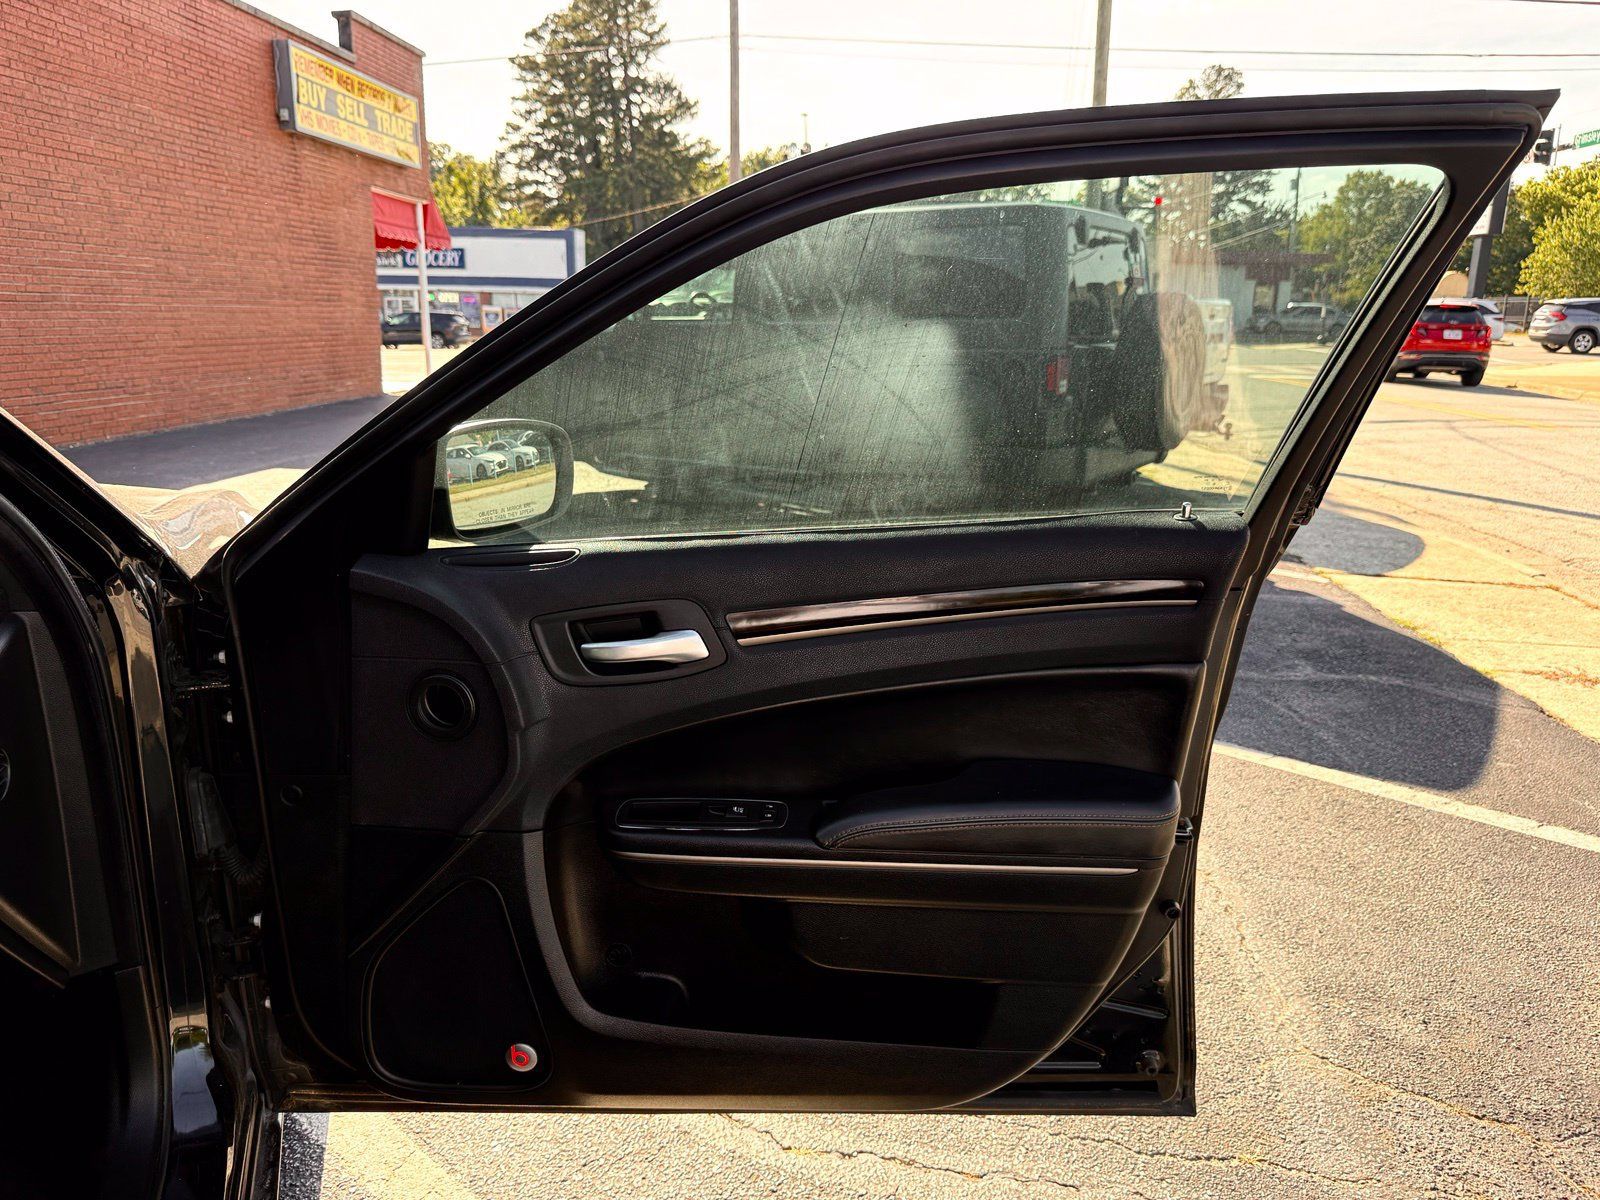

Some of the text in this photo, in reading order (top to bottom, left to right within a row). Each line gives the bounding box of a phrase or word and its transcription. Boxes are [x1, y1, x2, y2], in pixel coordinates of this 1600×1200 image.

[336, 71, 356, 96] WHEN
[298, 77, 327, 112] BUY
[336, 93, 369, 127] SELL
[374, 109, 415, 143] TRADE
[475, 516, 494, 525] CLOSER
[519, 507, 535, 515] APPEAR
[479, 509, 498, 517] OBJECTS
